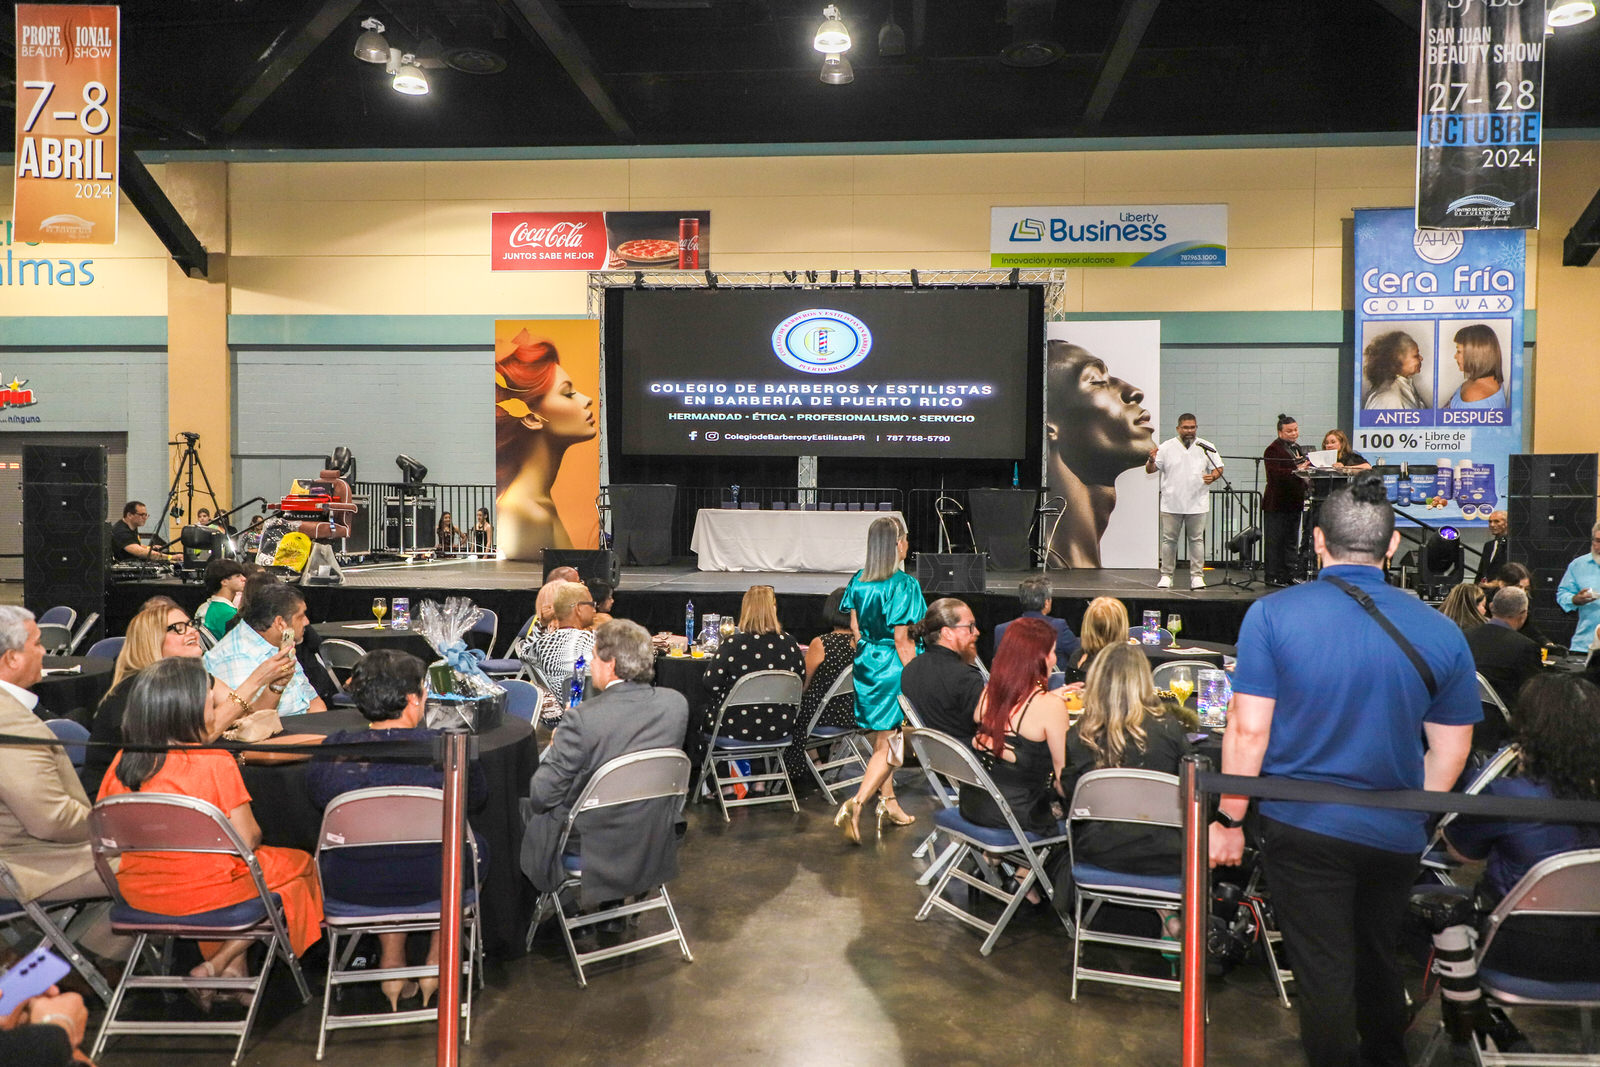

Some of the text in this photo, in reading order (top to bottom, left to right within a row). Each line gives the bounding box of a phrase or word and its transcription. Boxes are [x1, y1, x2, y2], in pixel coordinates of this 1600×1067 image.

[1428, 26, 1491, 44] SAN JUAN
[22, 47, 111, 58] BEAUTY SHOW
[1428, 43, 1542, 65] BEAUTY SHOW
[1428, 114, 1536, 144] OCTUBRE
[18, 136, 112, 180] ABRIL
[1482, 149, 1536, 168] 2024
[75, 183, 112, 199] 2024
[1120, 212, 1158, 223] Liberty
[509, 222, 587, 248] Coca-Cola
[1050, 218, 1167, 242] Business
[502, 252, 536, 260] JUNTOS
[539, 252, 562, 260] SABE
[1001, 256, 1045, 264] Innovación
[1054, 258, 1080, 266] mayor
[1083, 255, 1115, 264] alcance
[1362, 265, 1514, 294] Cera Fría
[1369, 298, 1507, 312] COLD WAX
[650, 384, 992, 395] COLEGIO DE BARBEROS Y ESTILISTAS
[684, 394, 963, 406] EN BARBERÍA DE PUERTO RICO
[752, 412, 787, 421] ÉTICA
[797, 414, 909, 422] PROFESIONALISMO
[1375, 408, 1504, 424] ANTES DESPUÉS
[724, 433, 865, 442] ColegiodeBarberosyEstilistasPR
[1360, 433, 1418, 449] 100 %
[1424, 432, 1466, 441] Libre de
[1424, 442, 1461, 450] Formol
